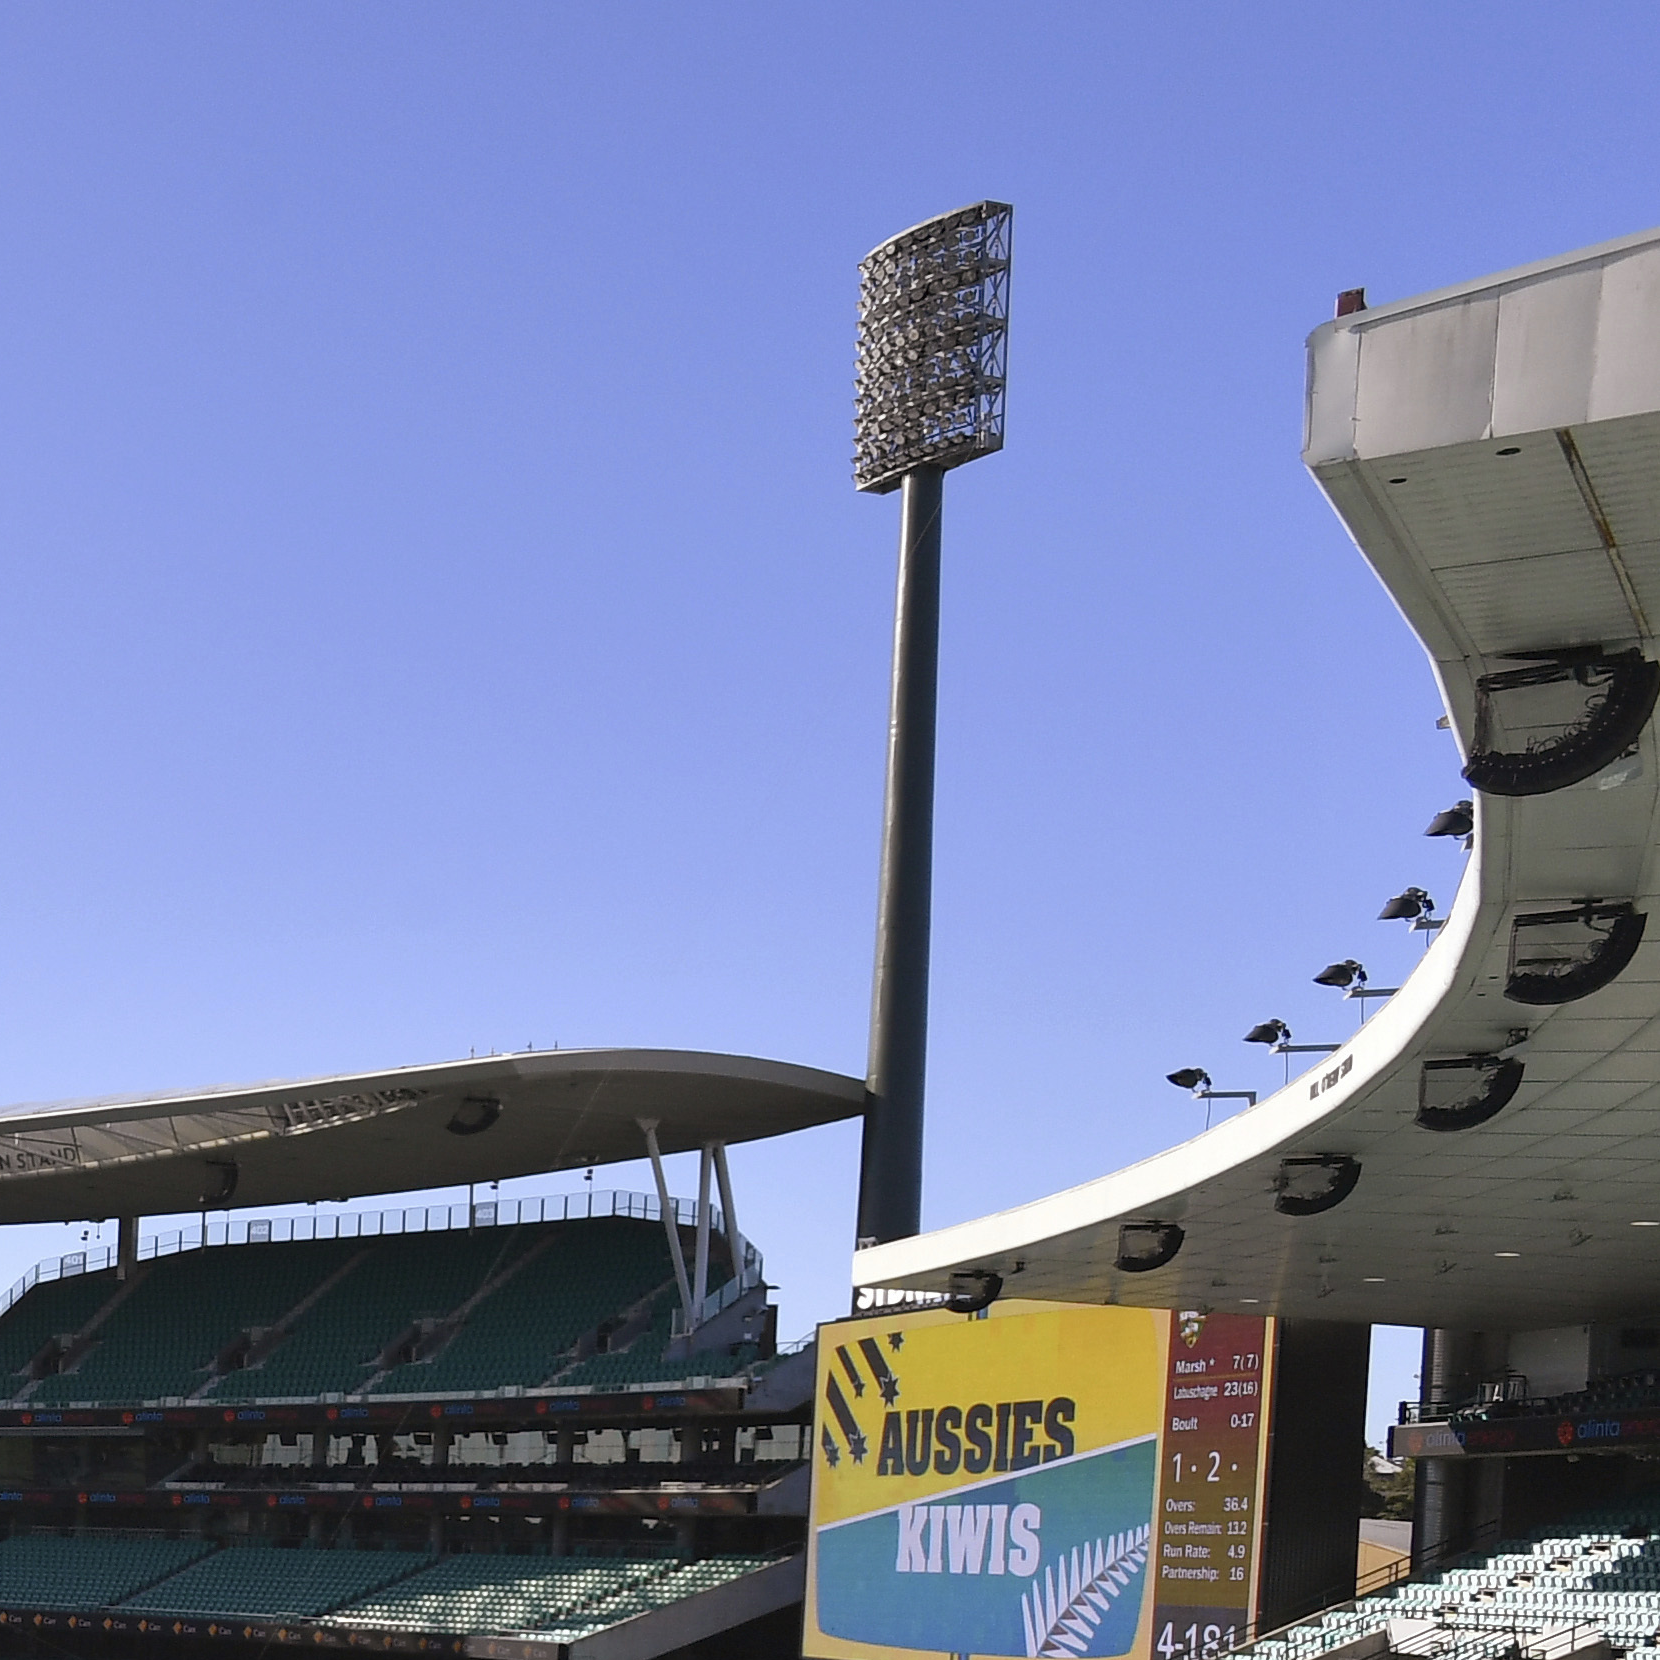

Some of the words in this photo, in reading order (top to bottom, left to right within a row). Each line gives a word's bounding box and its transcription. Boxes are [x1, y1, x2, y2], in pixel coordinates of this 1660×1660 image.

[17, 1147, 76, 1168] STAND
[1175, 1358, 1206, 1374] Marsh
[1173, 1385, 1218, 1400] Labuschagne
[1224, 1381, 1258, 1397] 23(16)
[1172, 1416, 1198, 1431] Boult
[1231, 1413, 1255, 1428] 0-17
[877, 1397, 1076, 1476] AUSSIES
[1207, 1451, 1221, 1482] 2
[1166, 1498, 1195, 1512] Overs:
[1224, 1497, 1248, 1511] 36.4
[1164, 1521, 1186, 1535] Overs
[1227, 1521, 1247, 1535] 13.2
[895, 1503, 1041, 1577] KIWIS
[1163, 1543, 1182, 1558] Run
[1185, 1544, 1211, 1558] Rate:
[1227, 1544, 1246, 1559] 4.9
[1162, 1565, 1219, 1582] Partnership:
[1229, 1566, 1244, 1581] 16
